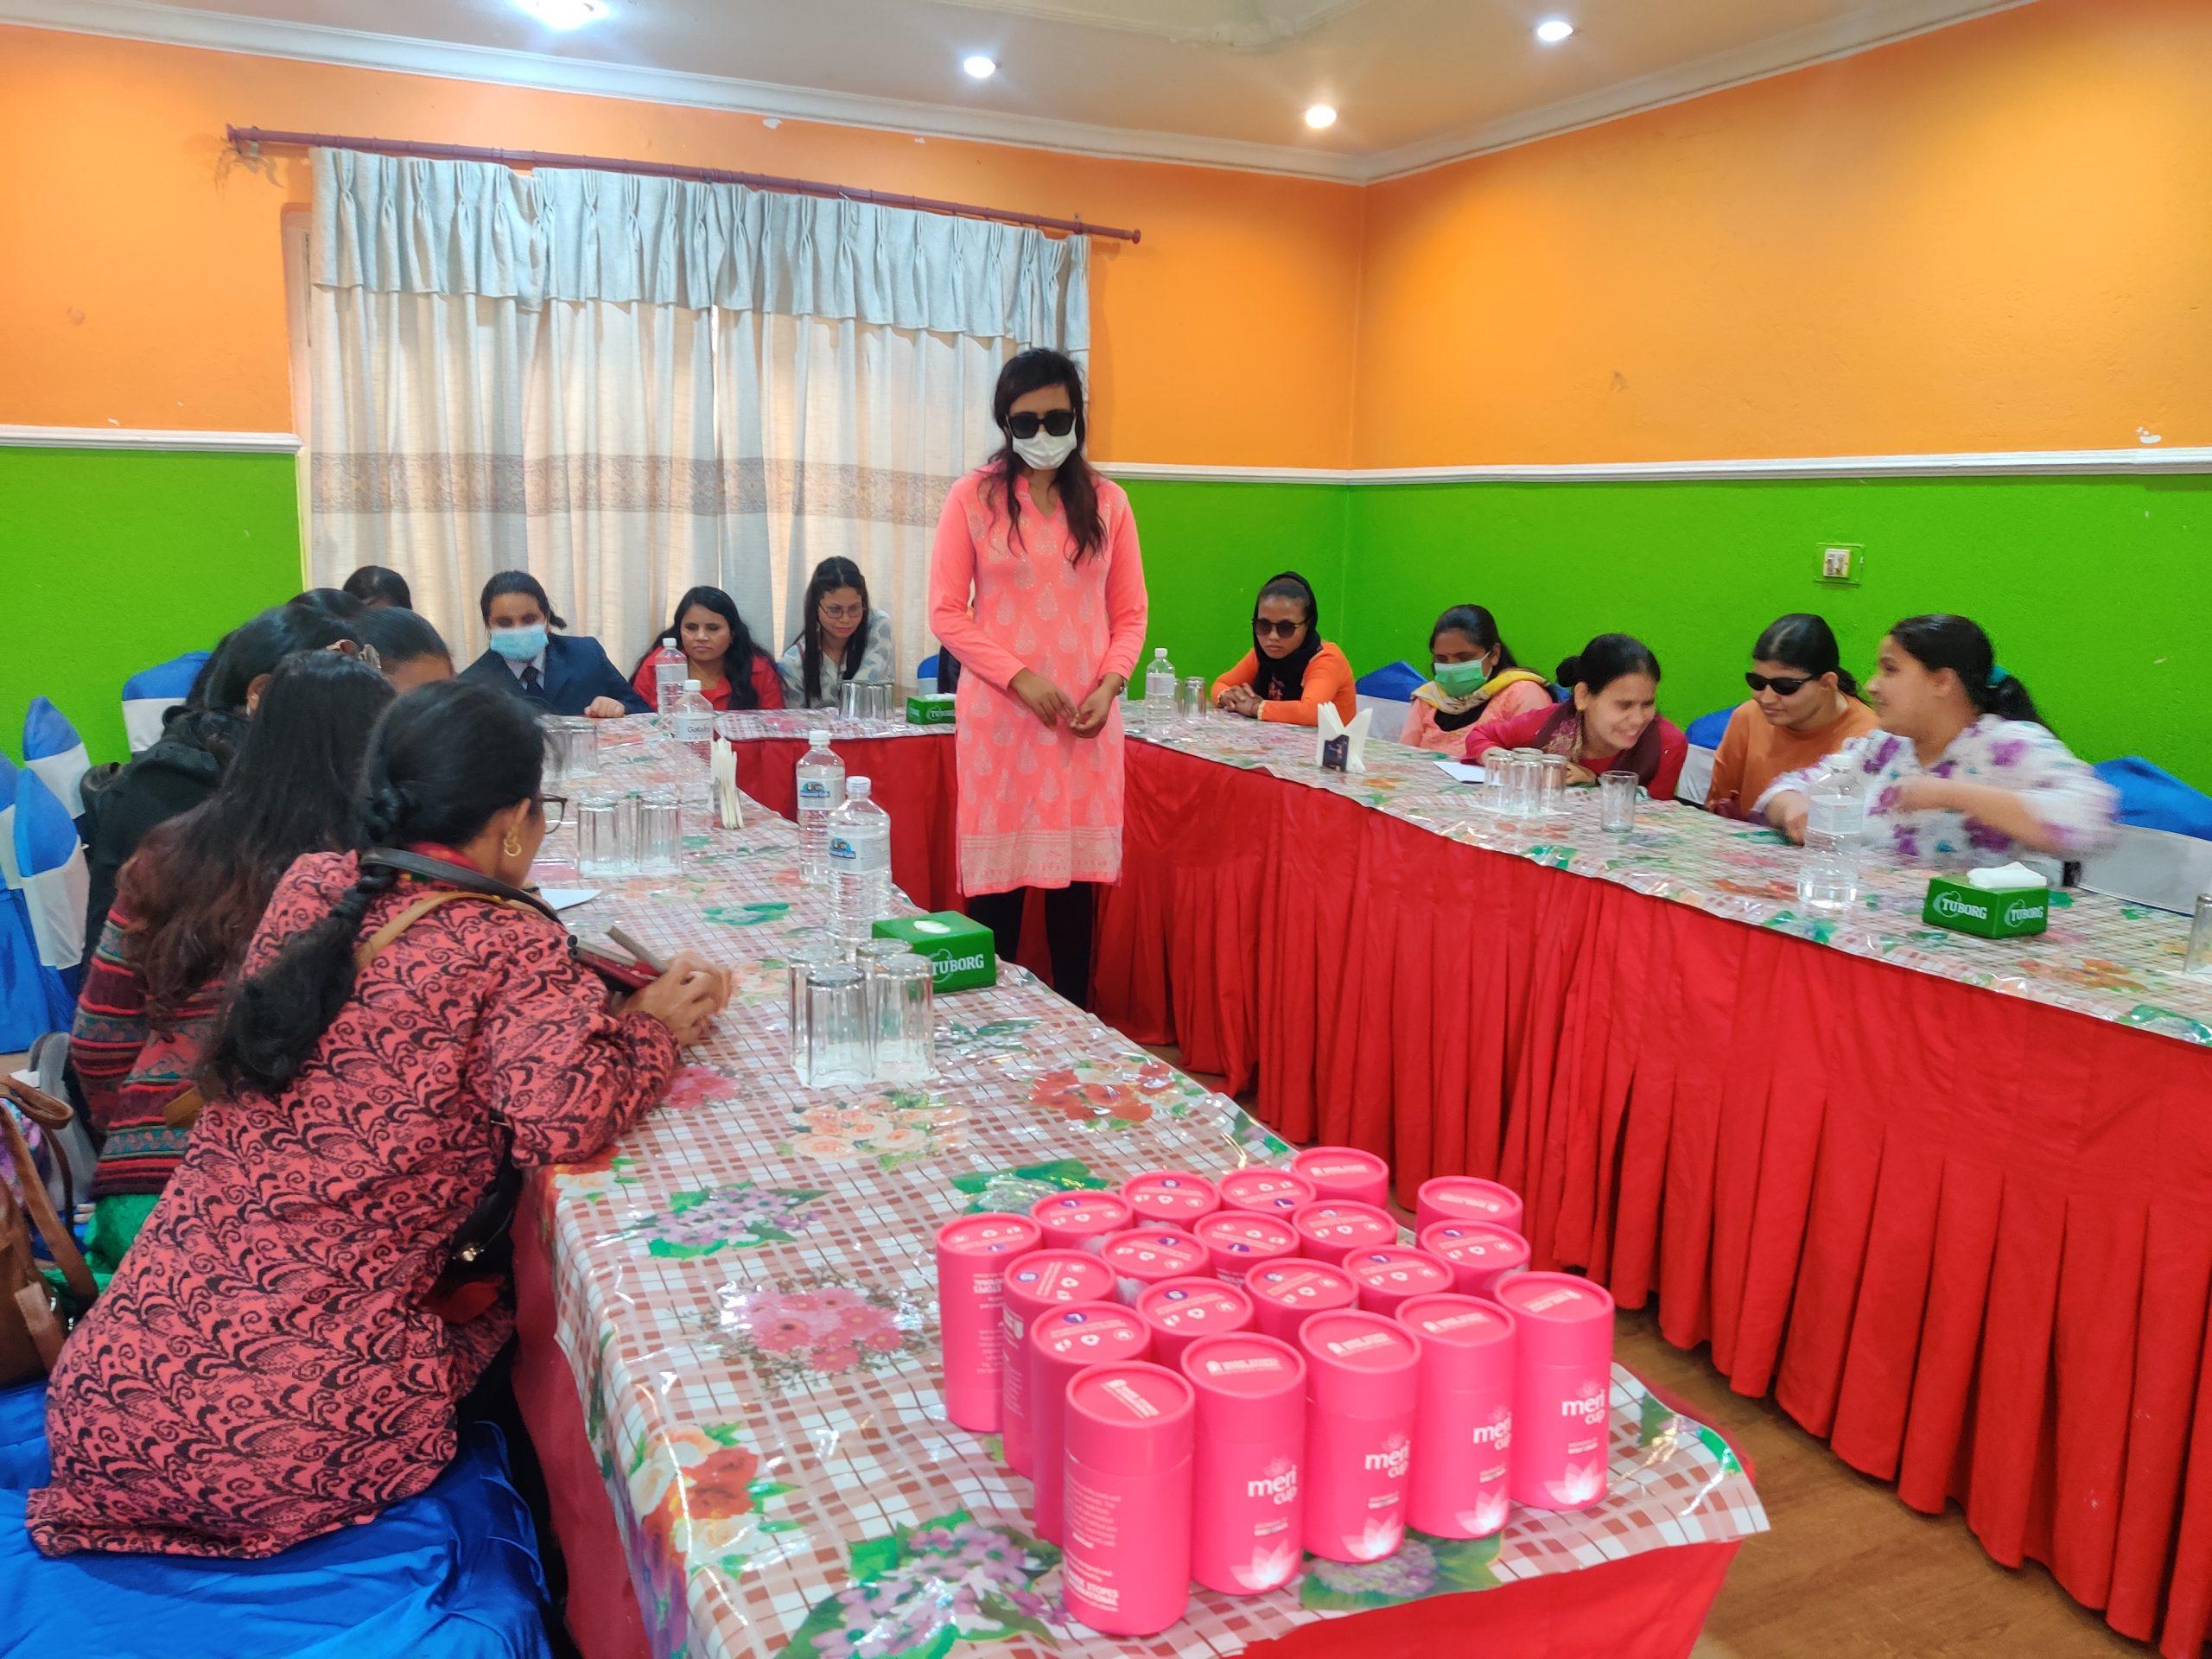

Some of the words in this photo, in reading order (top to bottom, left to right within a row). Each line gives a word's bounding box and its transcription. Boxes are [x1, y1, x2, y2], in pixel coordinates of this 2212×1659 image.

[1942, 898, 1987, 919] TUBORG
[2011, 906, 2044, 922] TUBORG
[932, 954, 984, 976] TUBORG
